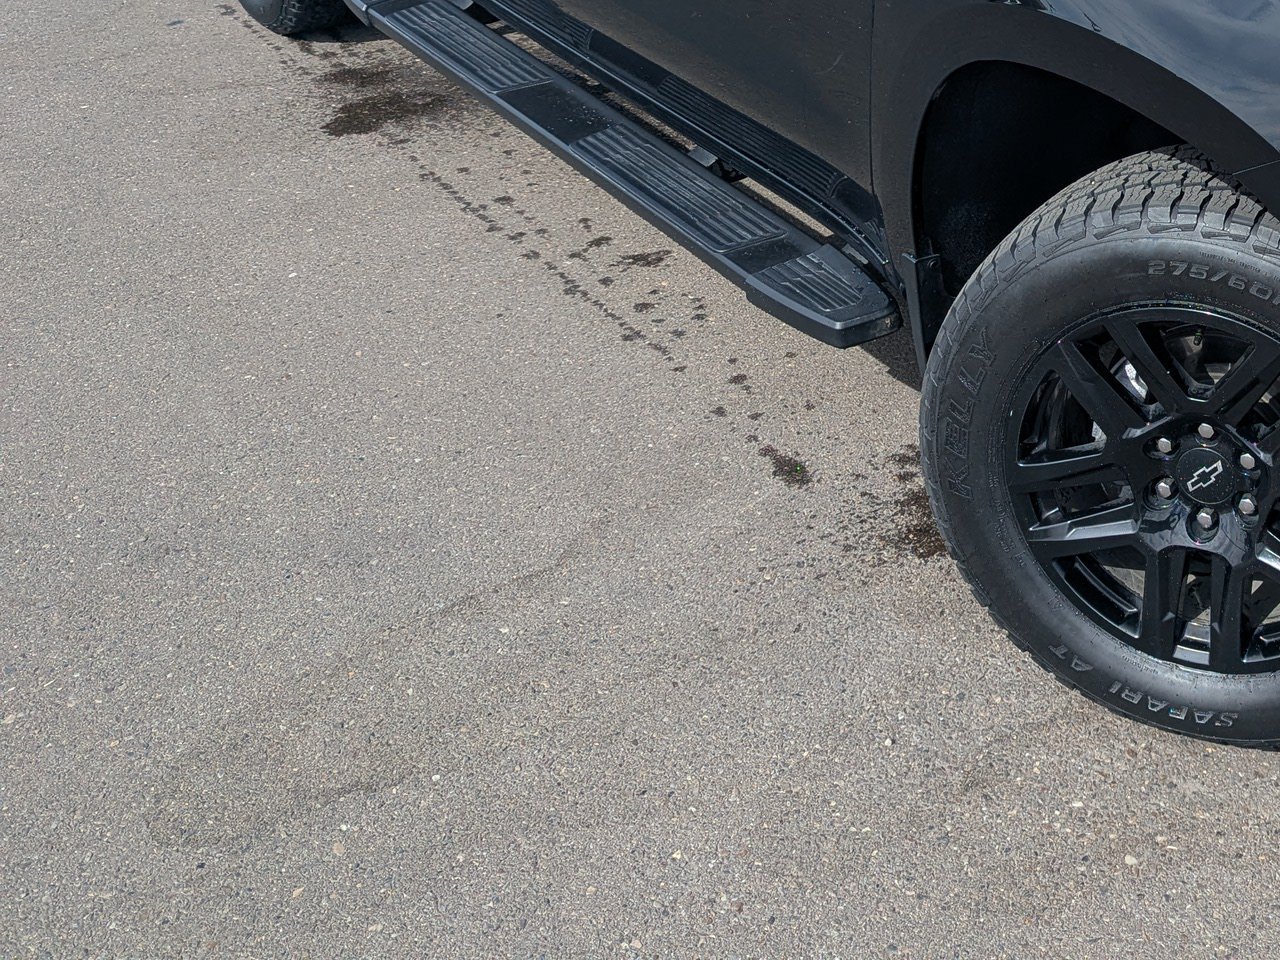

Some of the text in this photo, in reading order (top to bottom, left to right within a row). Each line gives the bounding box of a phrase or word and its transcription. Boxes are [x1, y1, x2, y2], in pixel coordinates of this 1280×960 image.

[944, 326, 996, 499] KELLY
[1048, 643, 1094, 672] AT
[1108, 680, 1239, 728] SAFARI
